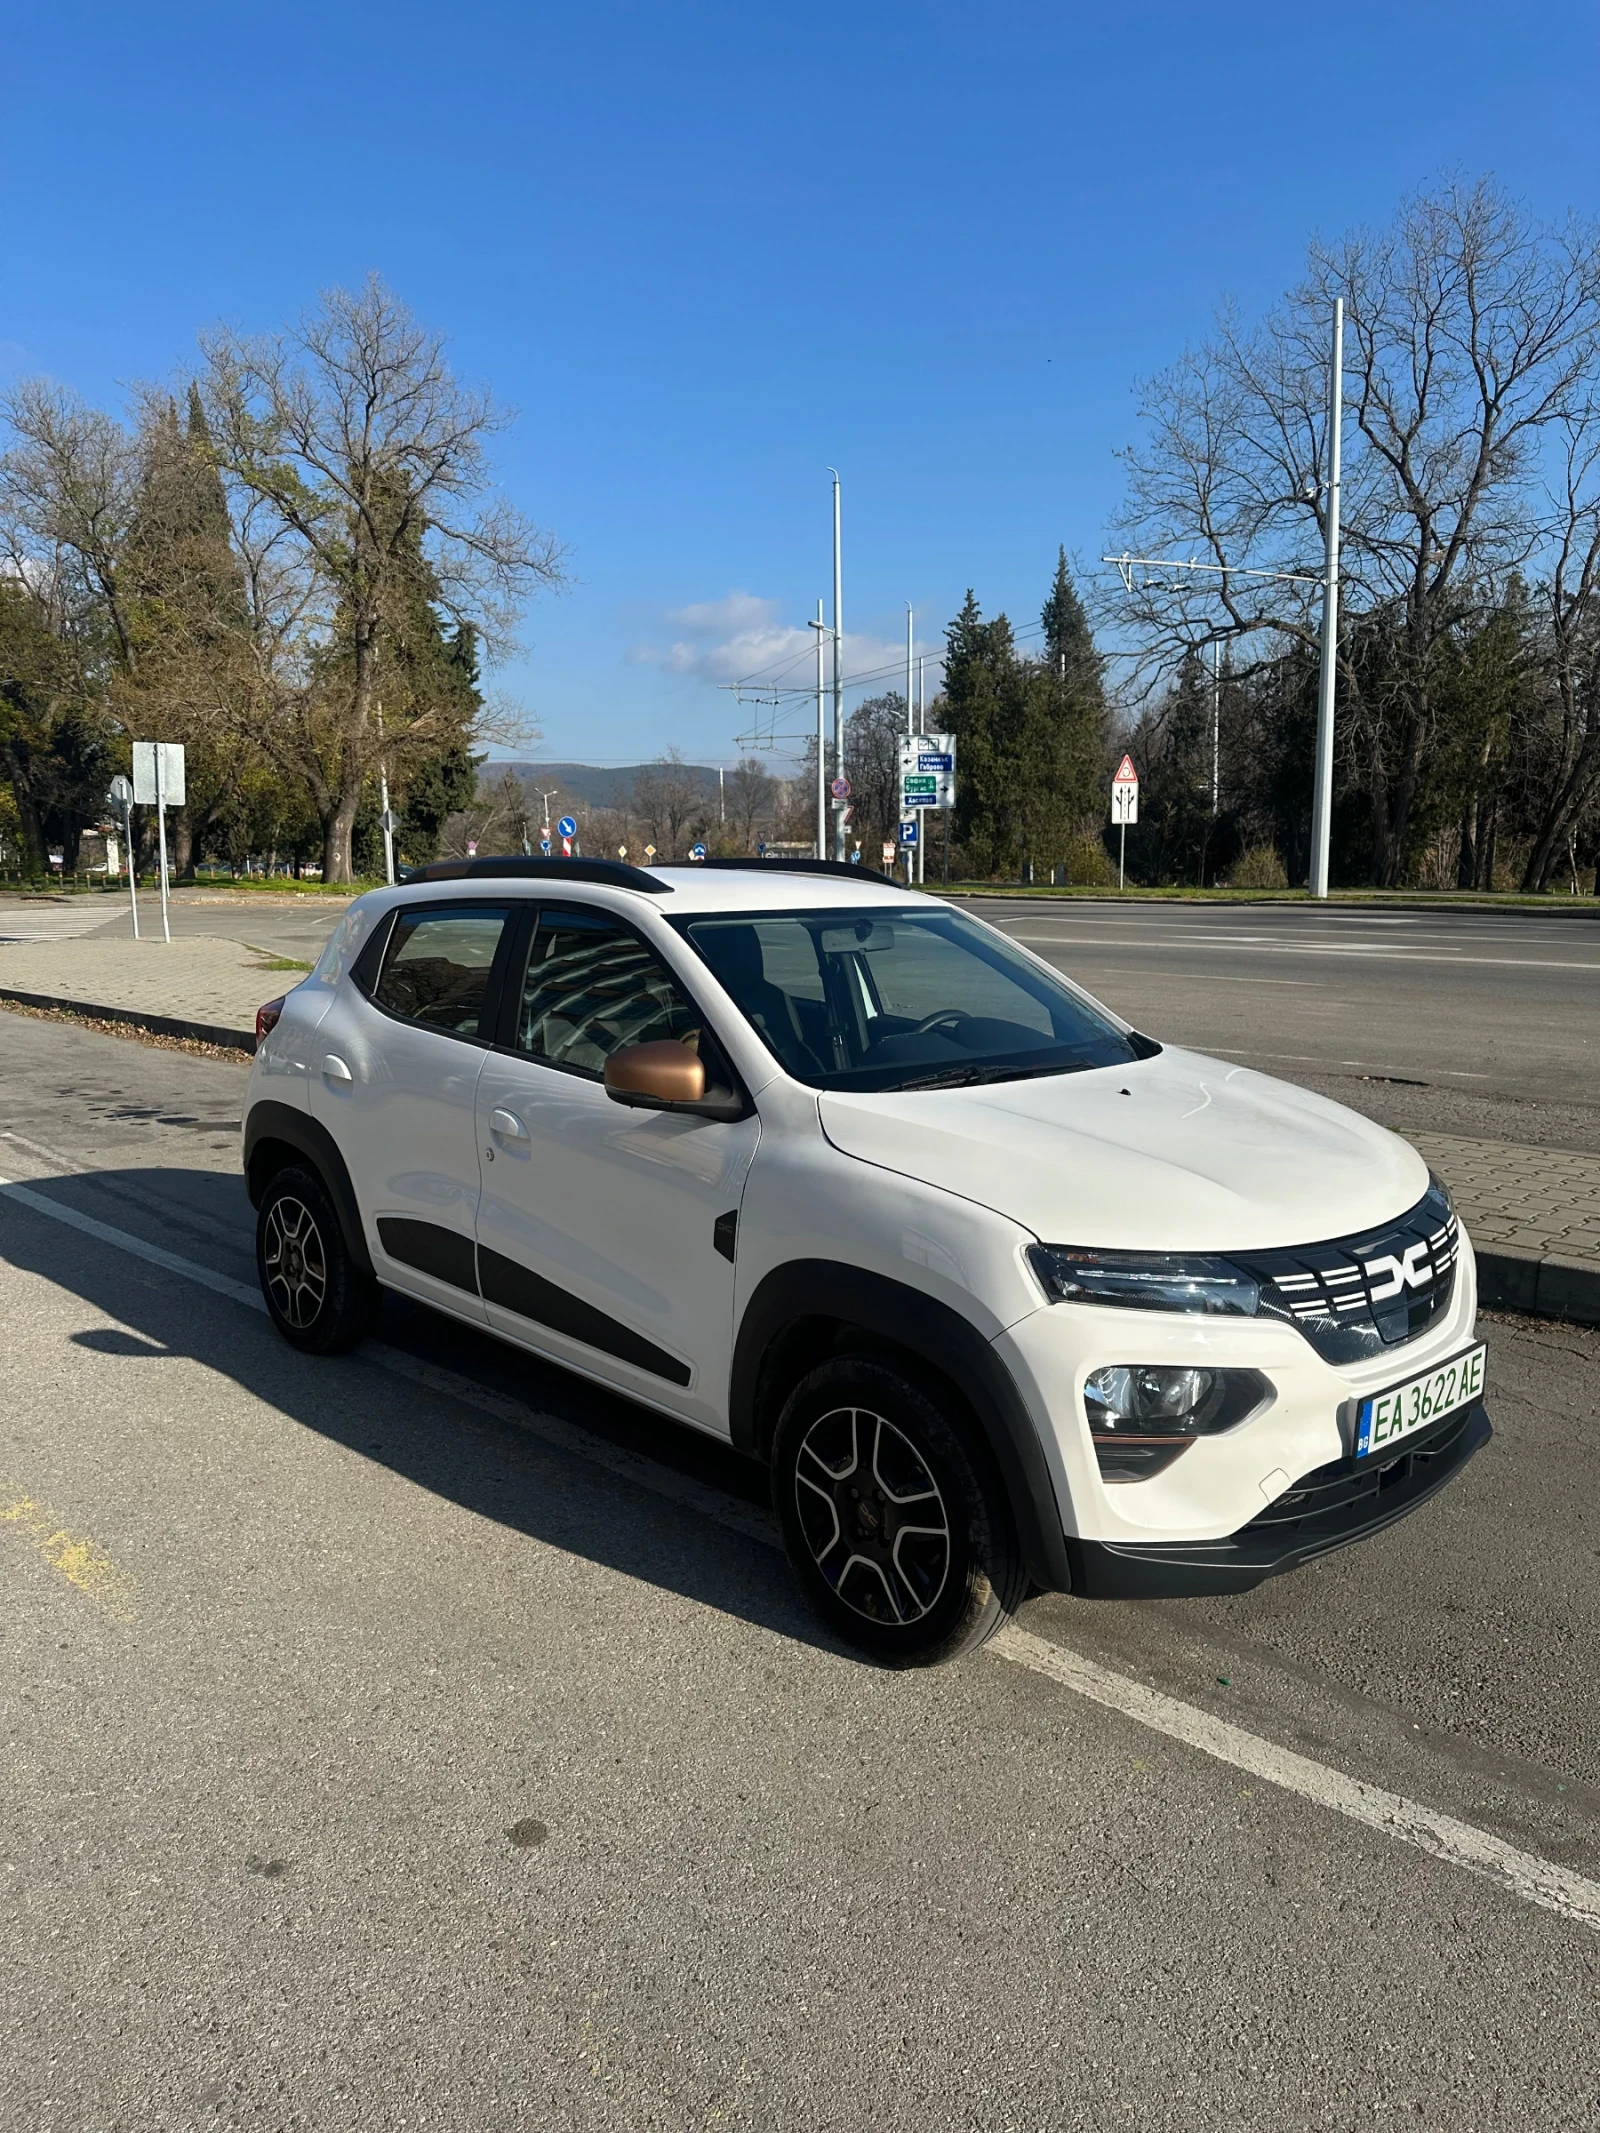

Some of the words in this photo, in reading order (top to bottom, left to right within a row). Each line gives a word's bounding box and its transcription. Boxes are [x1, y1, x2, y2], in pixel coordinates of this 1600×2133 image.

[920, 763, 944, 771] Габрово
[903, 825, 913, 840] P
[1374, 1394, 1403, 1444] EA
[1407, 1367, 1456, 1427] 3622
[1458, 1352, 1482, 1402] AE
[1358, 1436, 1369, 1451] BG
